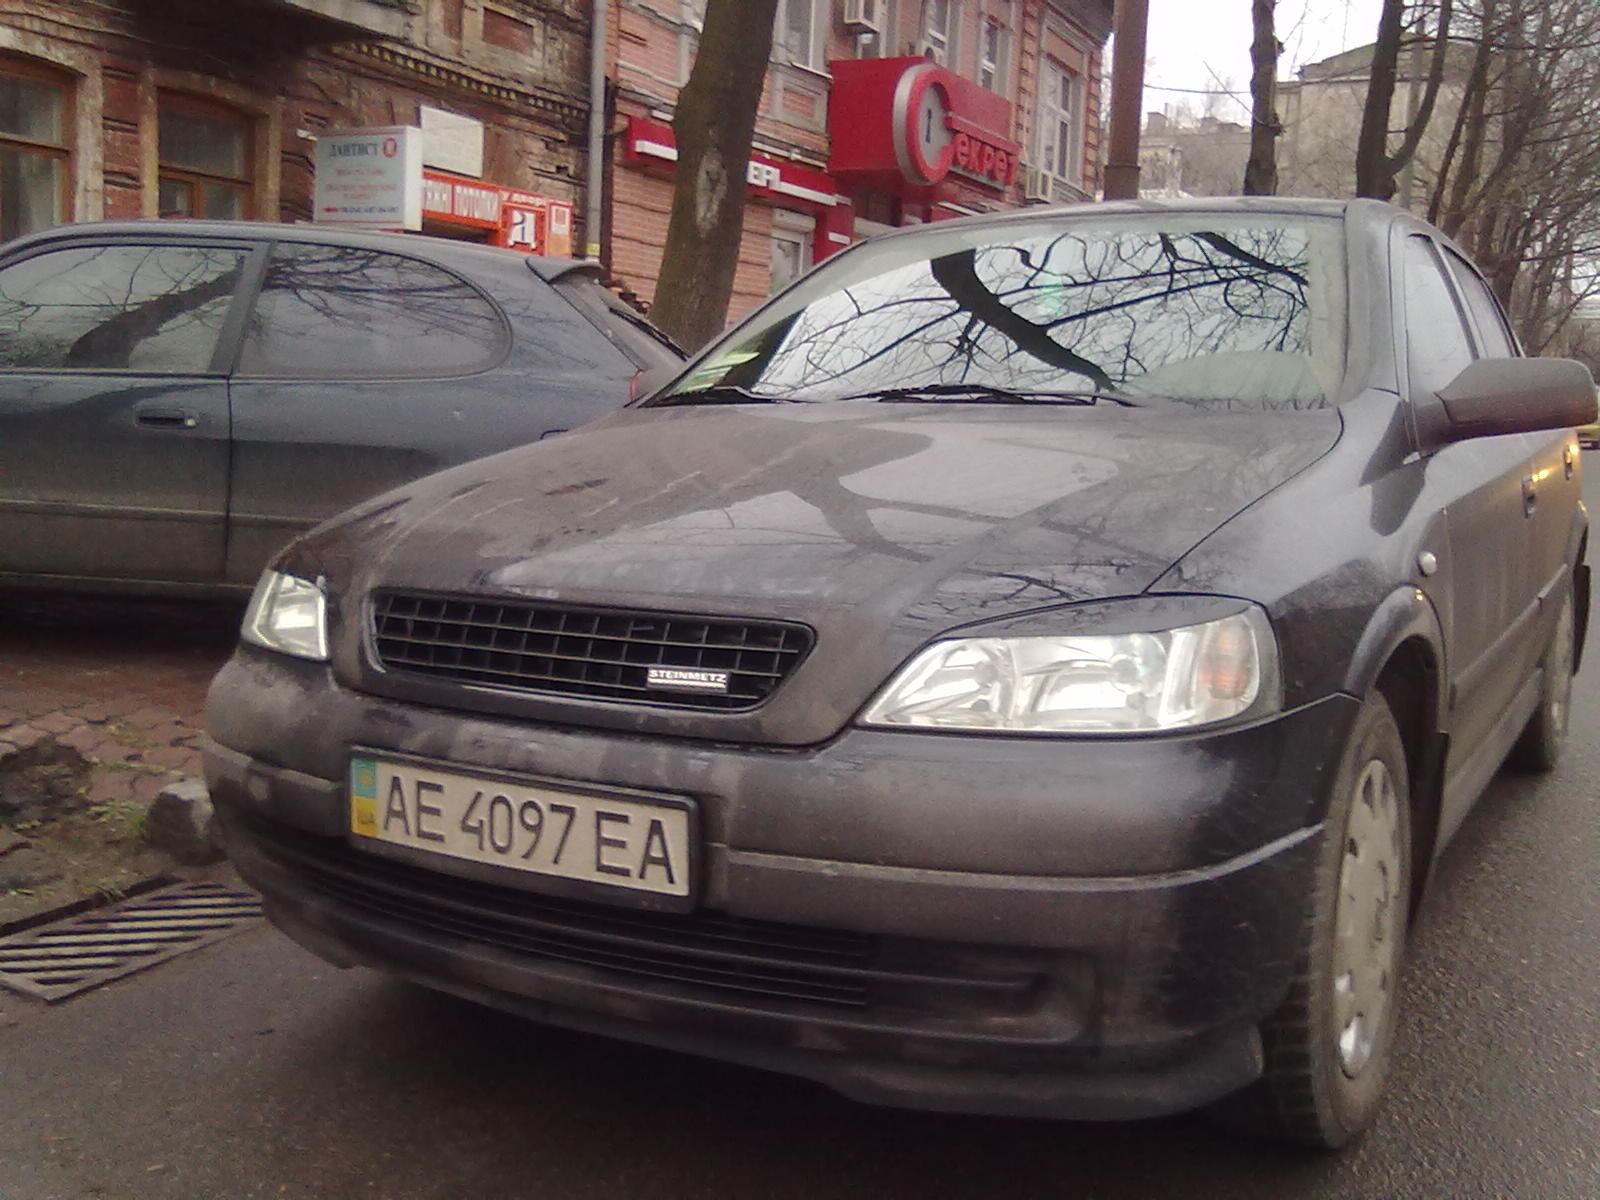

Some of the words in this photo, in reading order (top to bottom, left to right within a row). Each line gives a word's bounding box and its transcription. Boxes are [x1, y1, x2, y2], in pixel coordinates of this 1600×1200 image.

[648, 669, 727, 684] STEINMETZ
[383, 775, 446, 843] AE
[460, 790, 578, 866] 4097
[595, 810, 676, 885] EA
